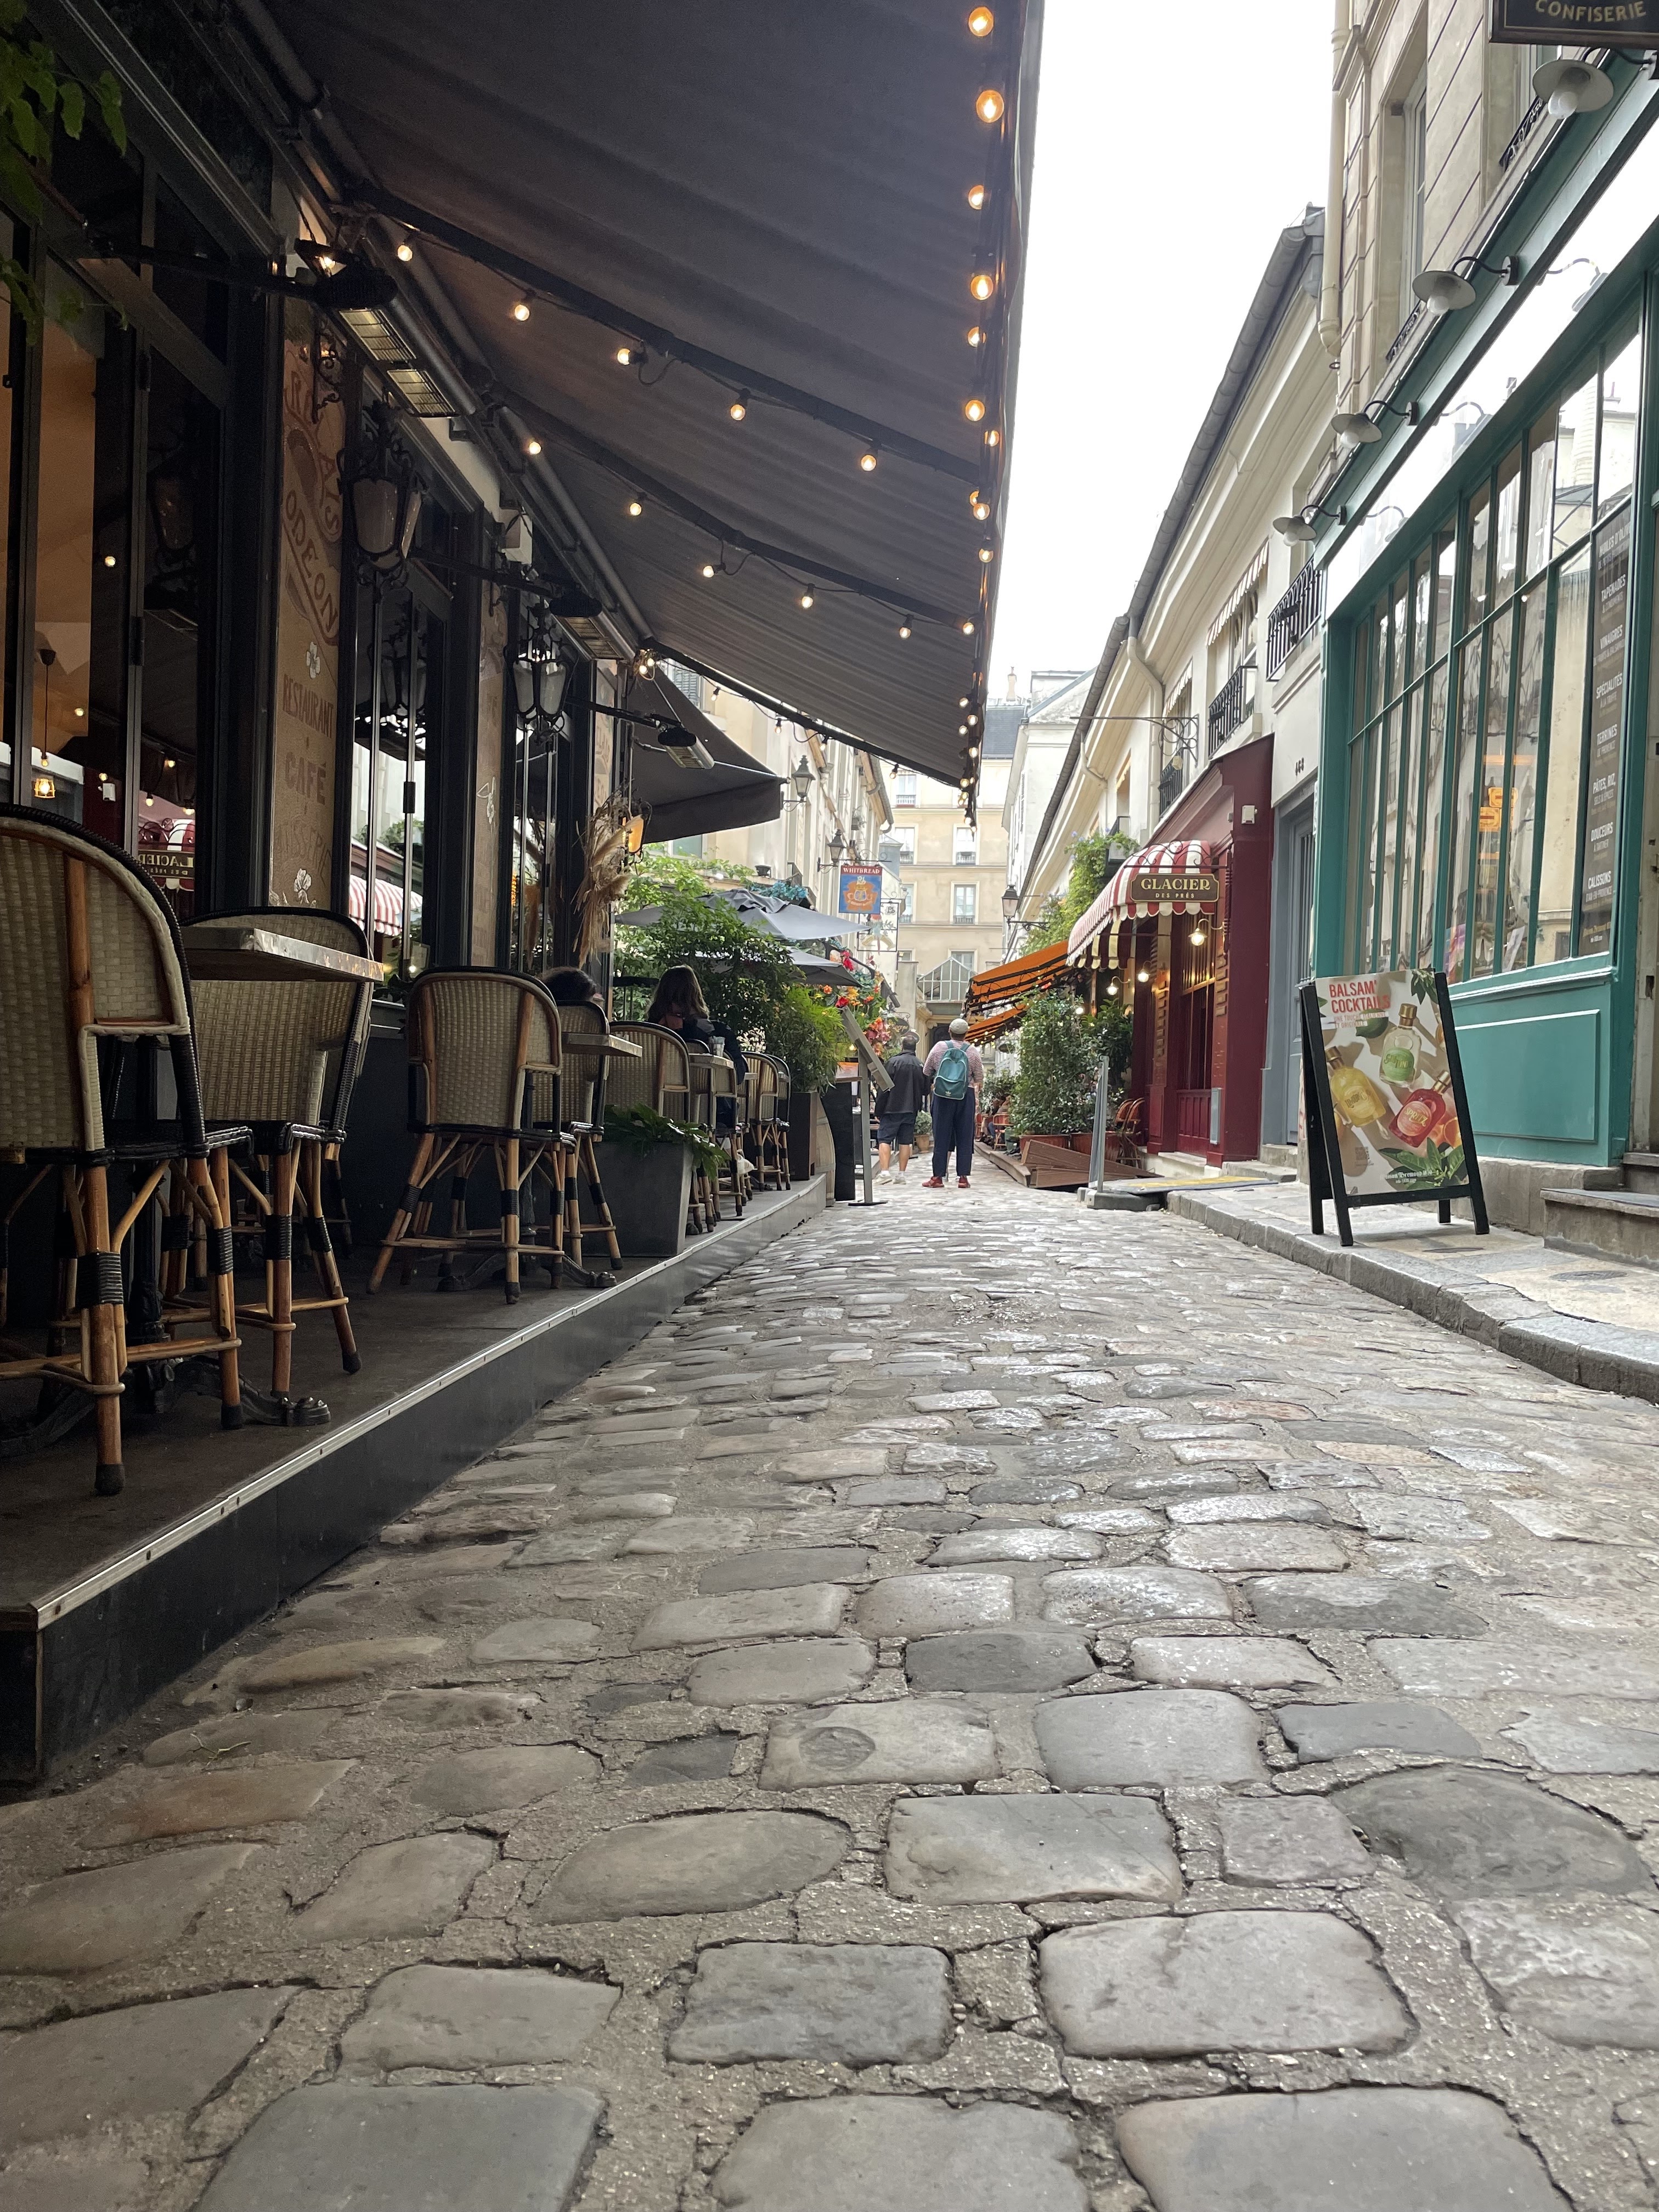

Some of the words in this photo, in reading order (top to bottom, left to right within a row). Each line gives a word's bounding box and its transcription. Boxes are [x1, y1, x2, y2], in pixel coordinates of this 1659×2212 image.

[1536, 0, 1646, 22] CONFISERIE
[1601, 574, 1626, 602] TAPENADES
[1600, 624, 1623, 650] VINAIGRES
[282, 673, 334, 739] RESTAURANT
[1597, 724, 1617, 746] TERRINES
[285, 752, 326, 806] CAFÉ
[1591, 821, 1613, 842] DOUCEURS
[1141, 878, 1211, 890] GLACIER
[1588, 871, 1611, 889] CALISSONS
[1329, 979, 1376, 998] BALSAM'
[1331, 995, 1391, 1013] COCKTAILS
[1405, 1107, 1428, 1127] SPRITZ
